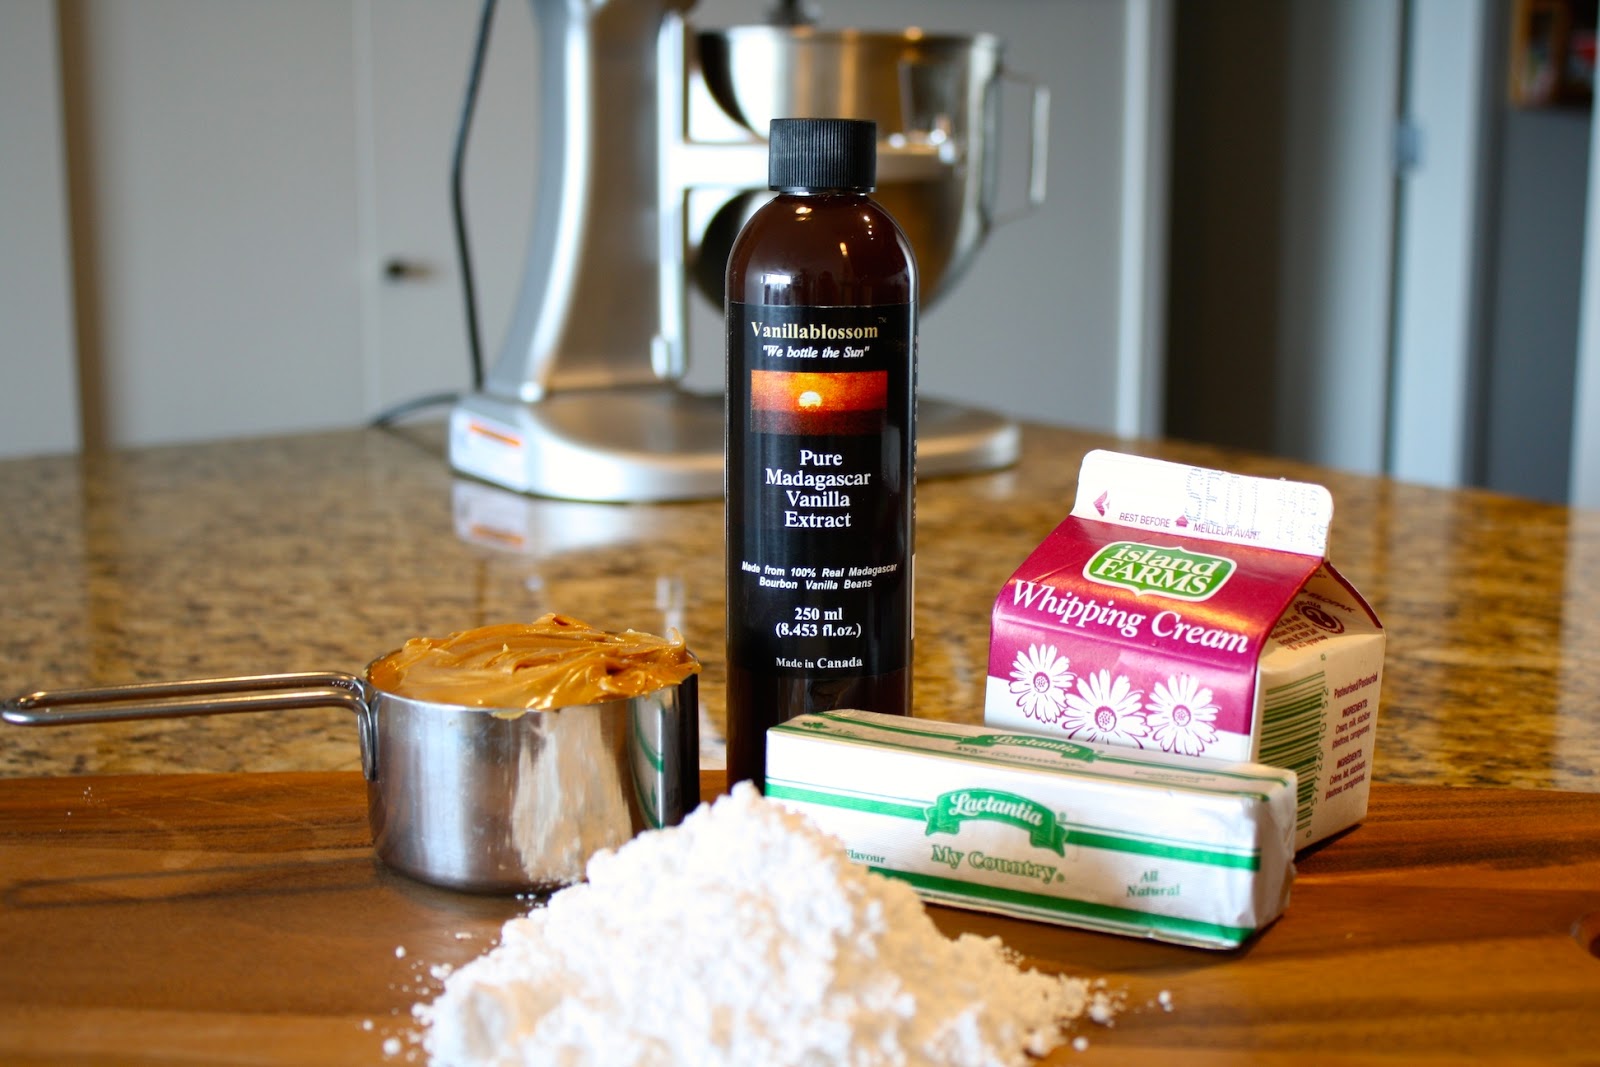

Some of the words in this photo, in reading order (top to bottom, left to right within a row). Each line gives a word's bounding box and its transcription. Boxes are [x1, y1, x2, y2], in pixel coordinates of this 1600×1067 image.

[751, 322, 878, 340] Vanillablossom
[786, 347, 818, 359] bottle
[822, 347, 839, 359] the
[843, 346, 870, 359] Sun"
[799, 450, 843, 466] Pure
[765, 468, 871, 490] Madagascar
[786, 490, 851, 507] Vanilla
[784, 511, 852, 528] Extract
[1119, 512, 1140, 523] BEST
[1140, 515, 1171, 528] BEFORE
[1193, 522, 1233, 537] MEILLEUR
[742, 561, 760, 573] Made
[764, 565, 785, 576] from
[791, 567, 816, 578] 100%
[822, 568, 844, 578] Real
[848, 563, 898, 577] Madagascar
[1113, 545, 1222, 577] island
[759, 576, 798, 589] Bourbon
[805, 580, 838, 590] Vanilla
[843, 578, 873, 590] Beans
[1093, 558, 1213, 595] FARMS
[794, 607, 820, 620] 250
[824, 607, 843, 620] ml
[1012, 579, 1146, 638] Whipping
[1151, 610, 1249, 654] Cream
[775, 622, 818, 638] (8.453
[776, 657, 802, 668] Made
[805, 658, 814, 668] in
[817, 657, 863, 669] Canada
[948, 792, 1044, 827] Lactantia
[931, 845, 963, 869] My
[968, 851, 1058, 885] Country
[1140, 871, 1159, 883] All
[1126, 884, 1181, 898] Natural
